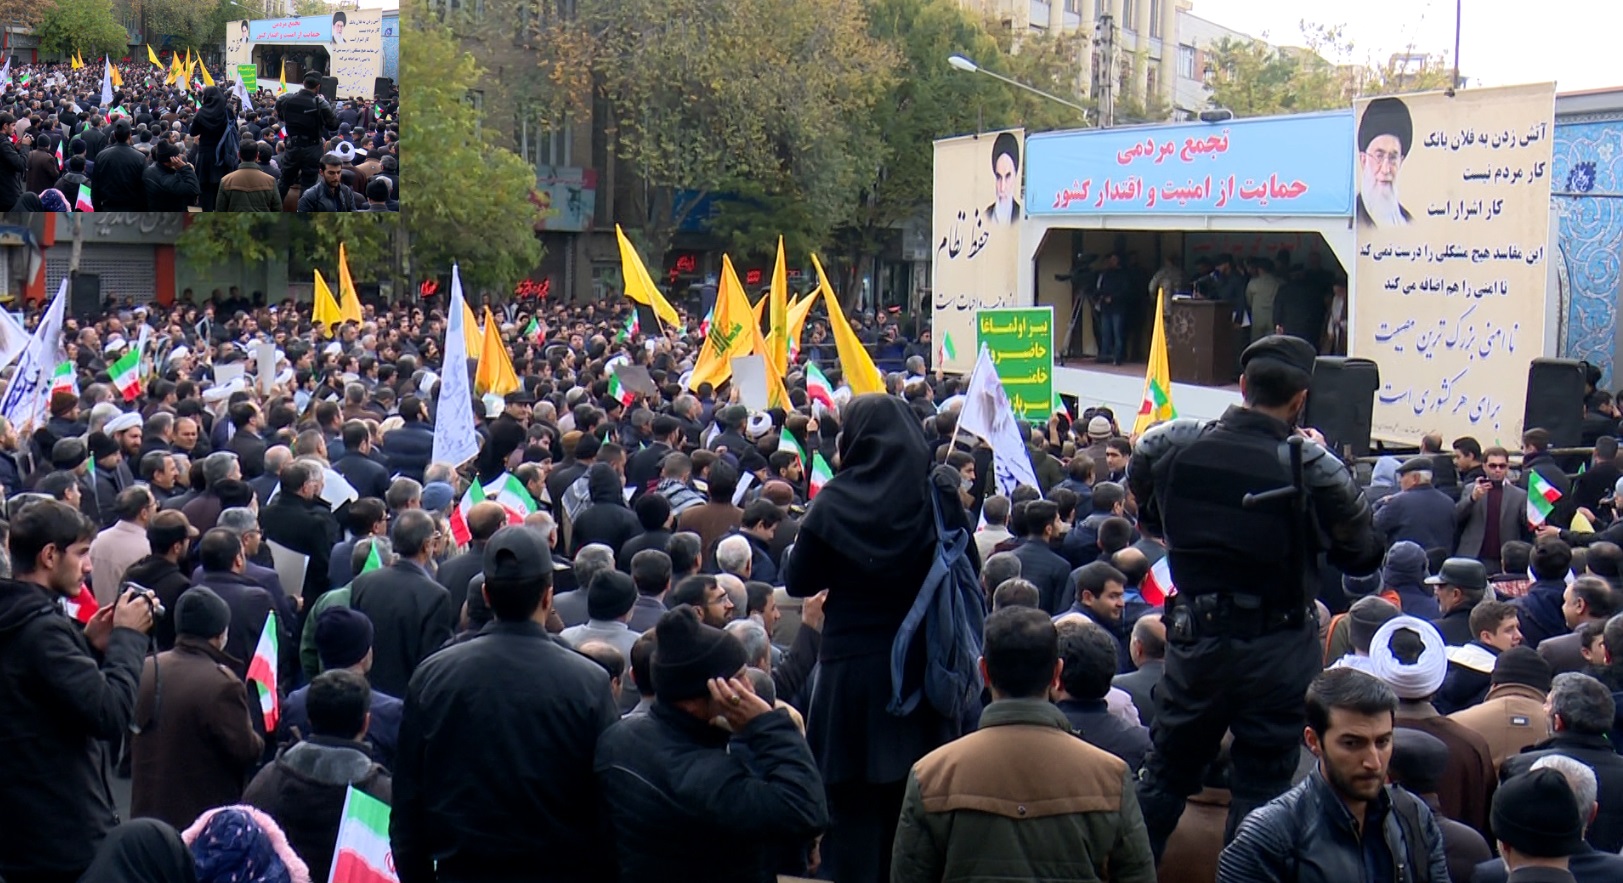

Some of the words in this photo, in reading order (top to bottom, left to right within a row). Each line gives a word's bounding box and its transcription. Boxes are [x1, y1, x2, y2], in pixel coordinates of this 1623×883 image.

[1424, 132, 1448, 150] بانک
[1450, 130, 1474, 150] فلان
[1478, 132, 1488, 148] به
[1492, 130, 1515, 148] زدن
[1520, 122, 1546, 146] آتش
[1118, 138, 1174, 164] مردمی
[1181, 129, 1229, 160] تجمع
[1463, 164, 1491, 183] نیست
[1494, 167, 1522, 184] مردم
[1528, 162, 1546, 183] کار
[1052, 178, 1090, 208] کشور
[1095, 176, 1142, 206] اقتدار
[1146, 186, 1155, 206] و
[1162, 176, 1210, 205] امنیت
[1216, 175, 1233, 206] از
[1240, 174, 1307, 204] حمایت
[1427, 200, 1450, 216] است
[1454, 200, 1482, 220] اشرار
[1486, 200, 1503, 220] کار
[936, 210, 966, 266] نظام
[968, 208, 989, 258] حفظ
[1373, 244, 1392, 260] نمی
[1395, 248, 1422, 261] درست
[1425, 244, 1432, 261] را
[1436, 244, 1468, 262] مشکلی
[1472, 248, 1490, 262] هیچ
[1494, 246, 1522, 260] مفاسد
[1526, 246, 1543, 264] این
[1384, 277, 1400, 290] کند
[1402, 284, 1416, 294] می
[1420, 276, 1444, 292] اضافه
[1446, 284, 1459, 295] هم
[1462, 280, 1470, 297] را
[1375, 320, 1415, 351] مصیبت
[1379, 384, 1412, 404] است
[1414, 369, 1468, 414] کشوری
[1453, 395, 1468, 413] هر
[1469, 397, 1500, 429] برای
